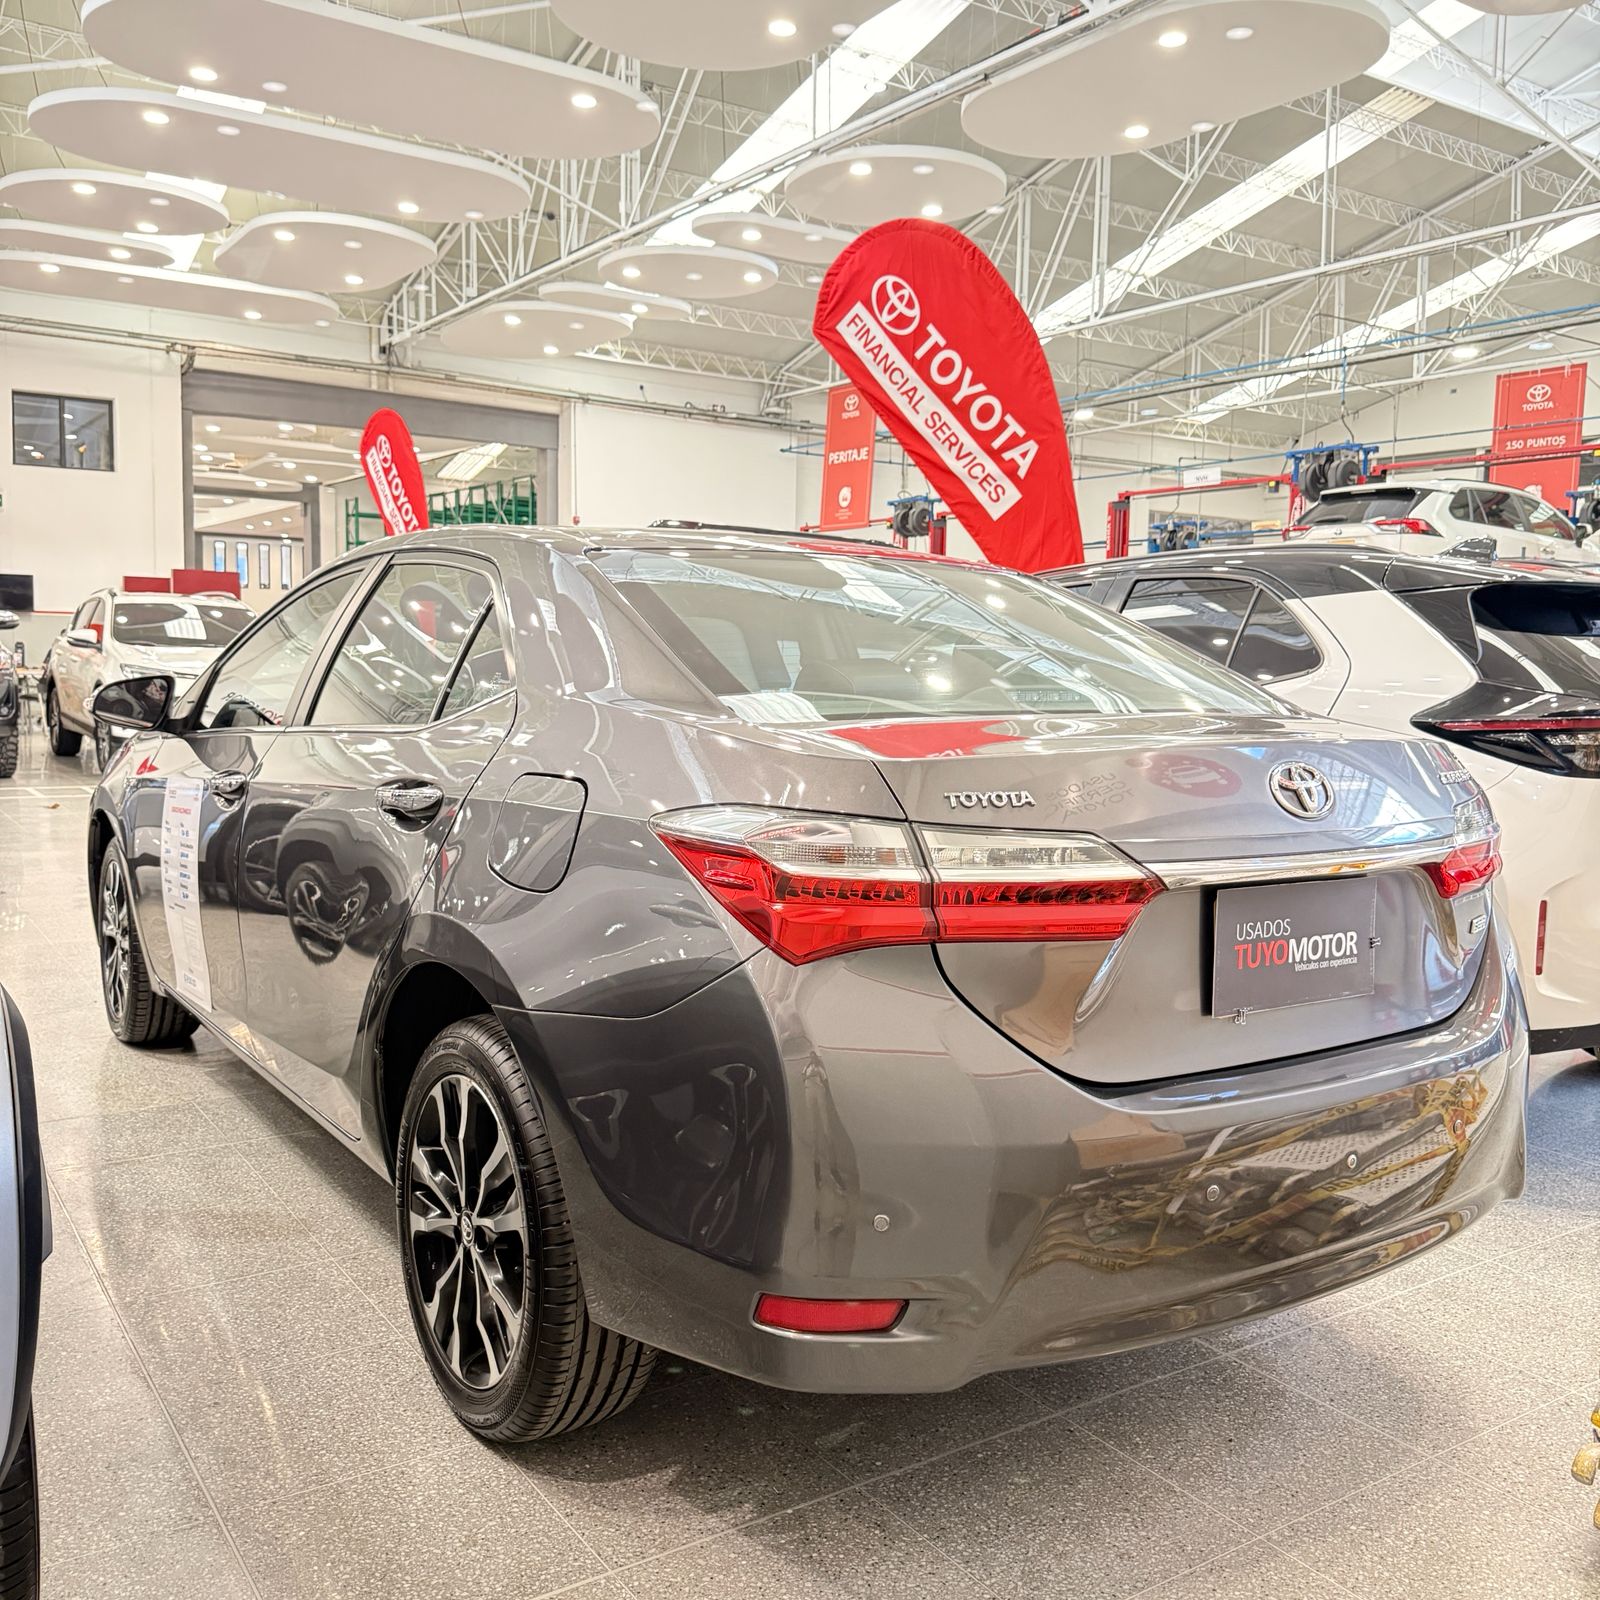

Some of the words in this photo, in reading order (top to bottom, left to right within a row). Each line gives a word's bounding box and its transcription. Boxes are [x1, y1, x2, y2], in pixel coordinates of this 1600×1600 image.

[846, 312, 929, 415] FINANCIAL
[924, 411, 1006, 504] SERVICES
[913, 323, 1040, 481] TOYOTA
[1522, 401, 1554, 412] TOYOTA
[1505, 440, 1524, 450] 150
[1526, 435, 1566, 448] PUNTOS
[829, 447, 869, 464] PERITAJE
[388, 463, 420, 531] TOYOT
[944, 790, 1036, 808] TOYOTA
[1236, 918, 1291, 941] USADOS
[1234, 931, 1358, 970] TUYOMOTOR
[1320, 960, 1329, 968] con
[1330, 956, 1358, 968] experiencia
